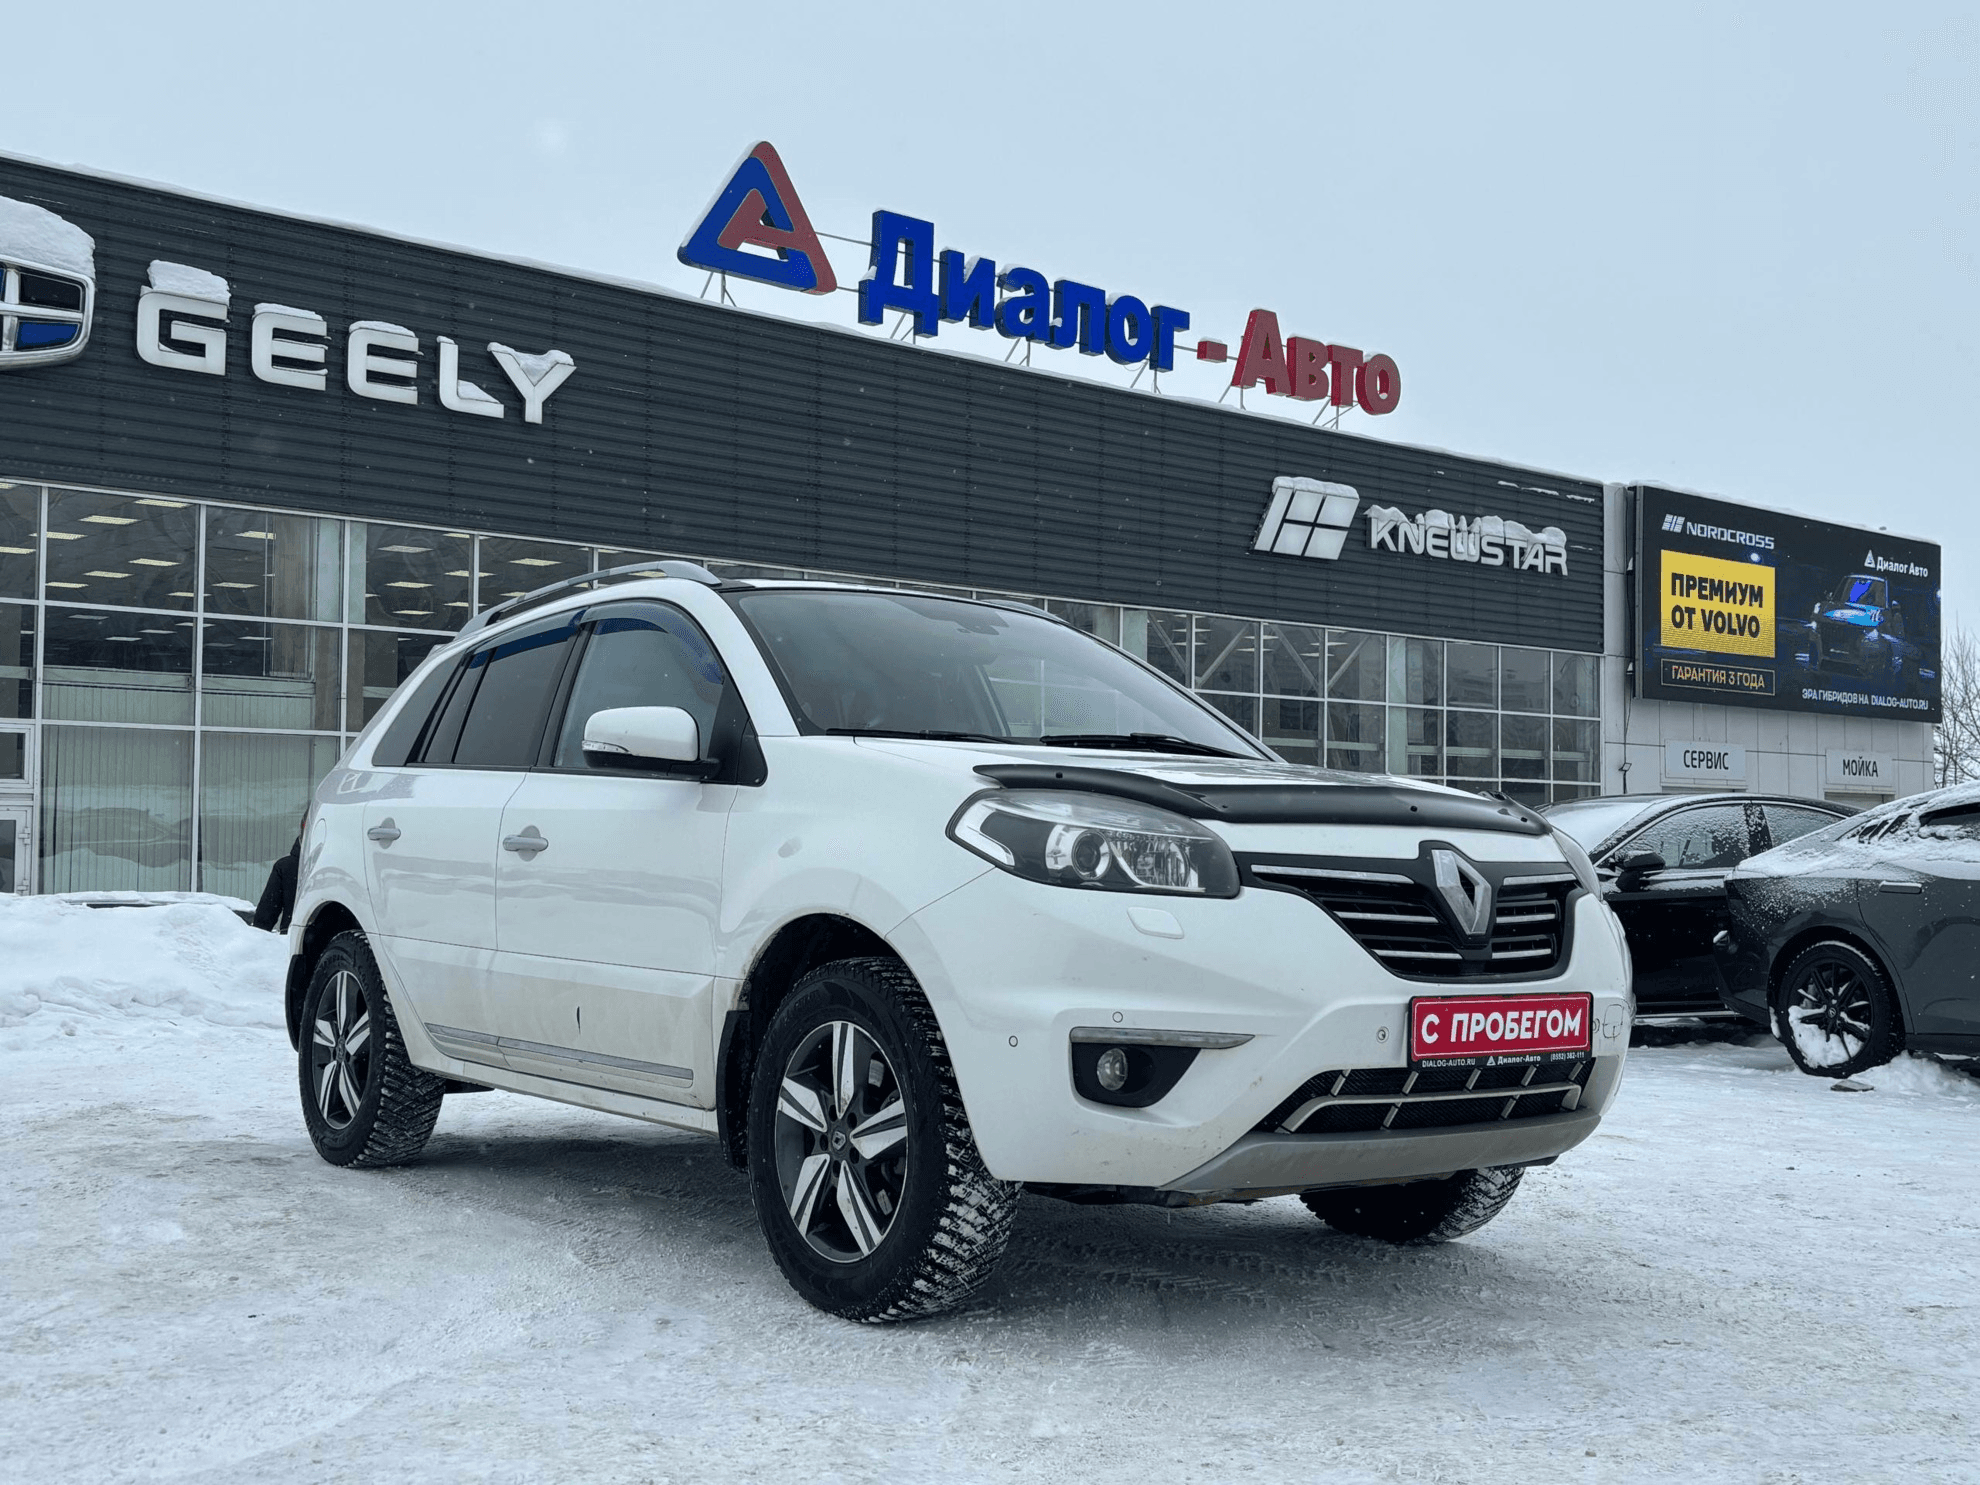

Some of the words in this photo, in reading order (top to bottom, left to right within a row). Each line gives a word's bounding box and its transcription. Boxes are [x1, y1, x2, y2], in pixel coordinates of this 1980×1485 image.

[136, 282, 577, 424] GEELY
[1368, 514, 1568, 576] KNEWSTAR
[1686, 521, 1775, 550] NORDCROSS
[1876, 556, 1908, 574] Диалог
[1909, 562, 1929, 578] Авто
[1671, 572, 1764, 609] ПРЕМИУМ
[1671, 604, 1696, 629] ОТ
[1701, 608, 1760, 639] VOLVO
[1671, 665, 1727, 685] ГАРАНТИЯ
[1728, 672, 1736, 686] 3
[1736, 673, 1765, 689] ГОДА
[1801, 688, 1818, 700] ЭРА
[1818, 689, 1858, 705] ГИБРИДОВ
[1858, 693, 1869, 705] НА
[1871, 695, 1929, 710] DIALOG-AUTO.RU
[1683, 750, 1729, 771] СЕРВИС
[1842, 756, 1879, 778] МОЙКА
[1421, 1013, 1440, 1044] С
[1450, 1008, 1582, 1043] ПРОБЕГОМ
[1422, 1058, 1476, 1068] DIALOG-AUTO.RU
[1497, 1054, 1541, 1065] Диалог-Авто
